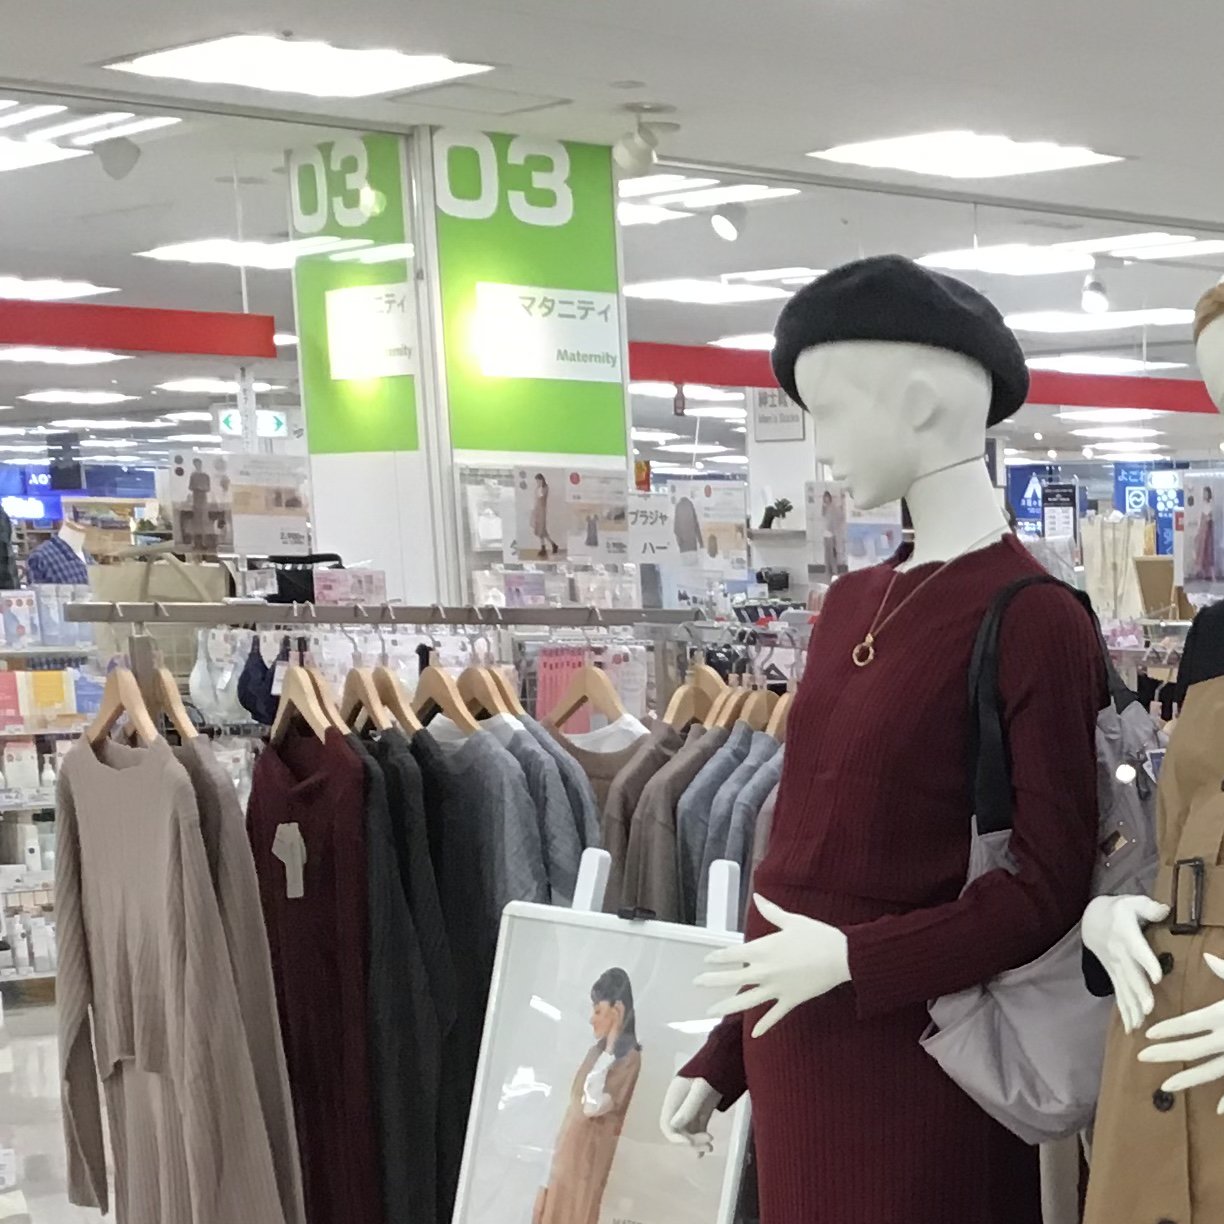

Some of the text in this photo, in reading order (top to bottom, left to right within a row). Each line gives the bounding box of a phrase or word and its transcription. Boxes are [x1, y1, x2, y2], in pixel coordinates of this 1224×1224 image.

[289, 136, 369, 233] 03
[431, 127, 574, 227] 03
[518, 295, 613, 323] マタニティ
[555, 348, 617, 368] Maternity
[28, 473, 52, 485] AO
[629, 509, 668, 526] ブラジャ
[642, 541, 670, 555] ハー
